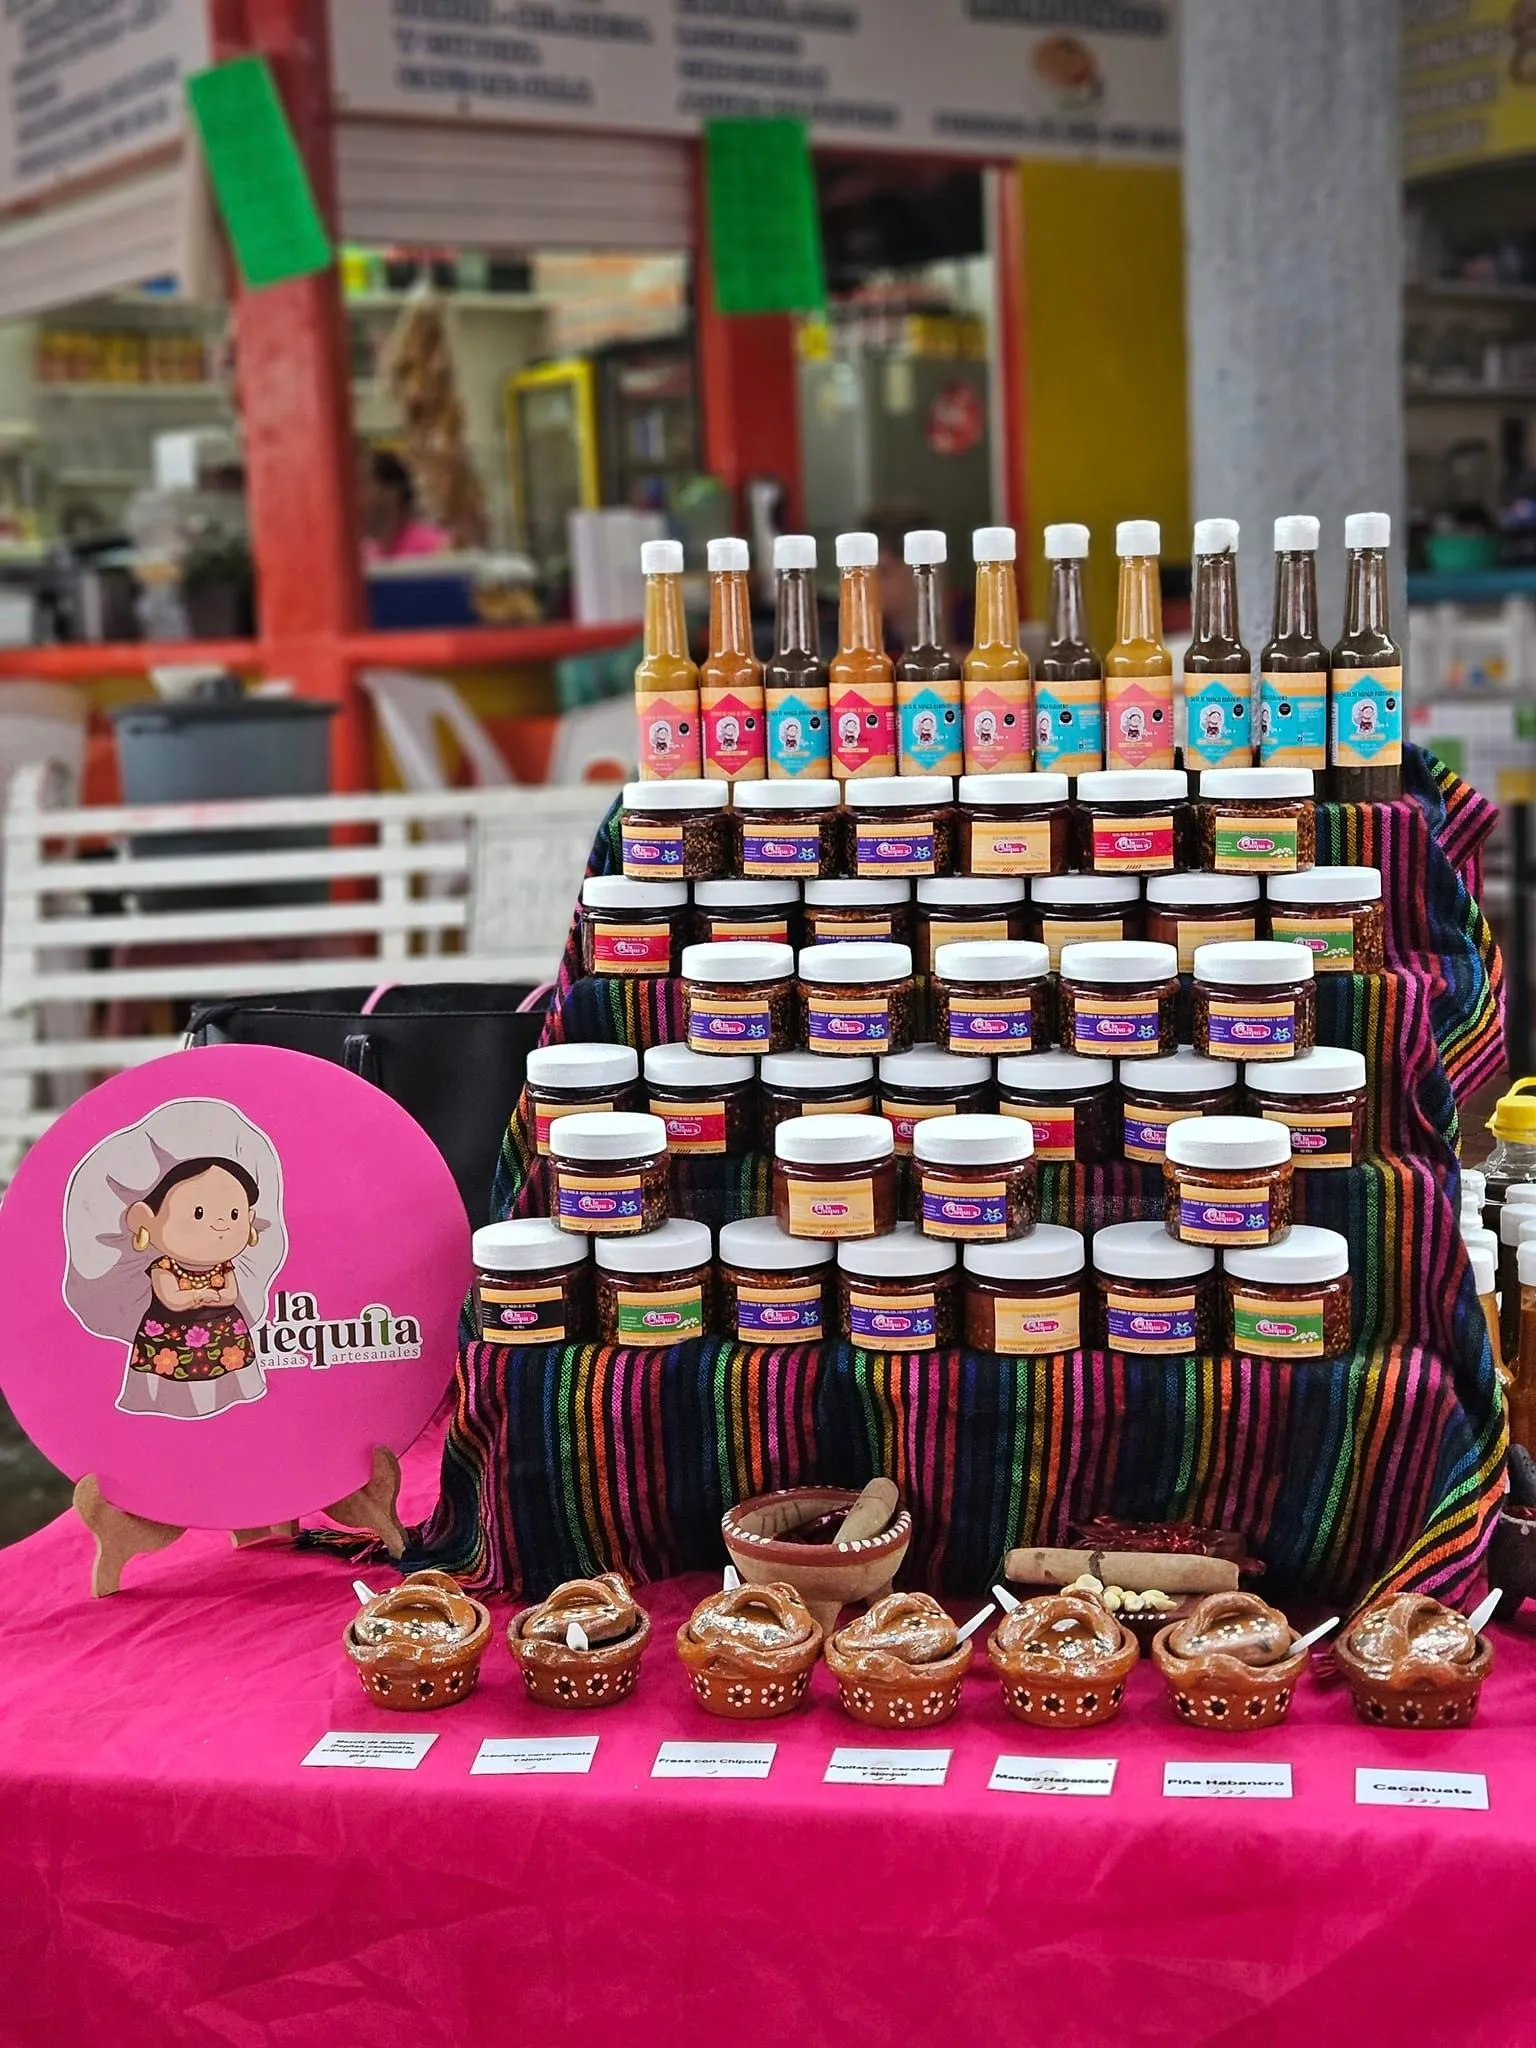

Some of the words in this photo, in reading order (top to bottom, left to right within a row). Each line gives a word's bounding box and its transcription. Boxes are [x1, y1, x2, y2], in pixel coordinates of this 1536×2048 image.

[275, 1290, 316, 1322] la
[257, 1307, 420, 1367] tequita
[260, 1355, 306, 1368] salsas
[331, 1347, 419, 1362] artesanales
[995, 1773, 1041, 1782] Mango
[1043, 1776, 1110, 1784] Habanero
[1373, 1783, 1472, 1794] Cacahuate
